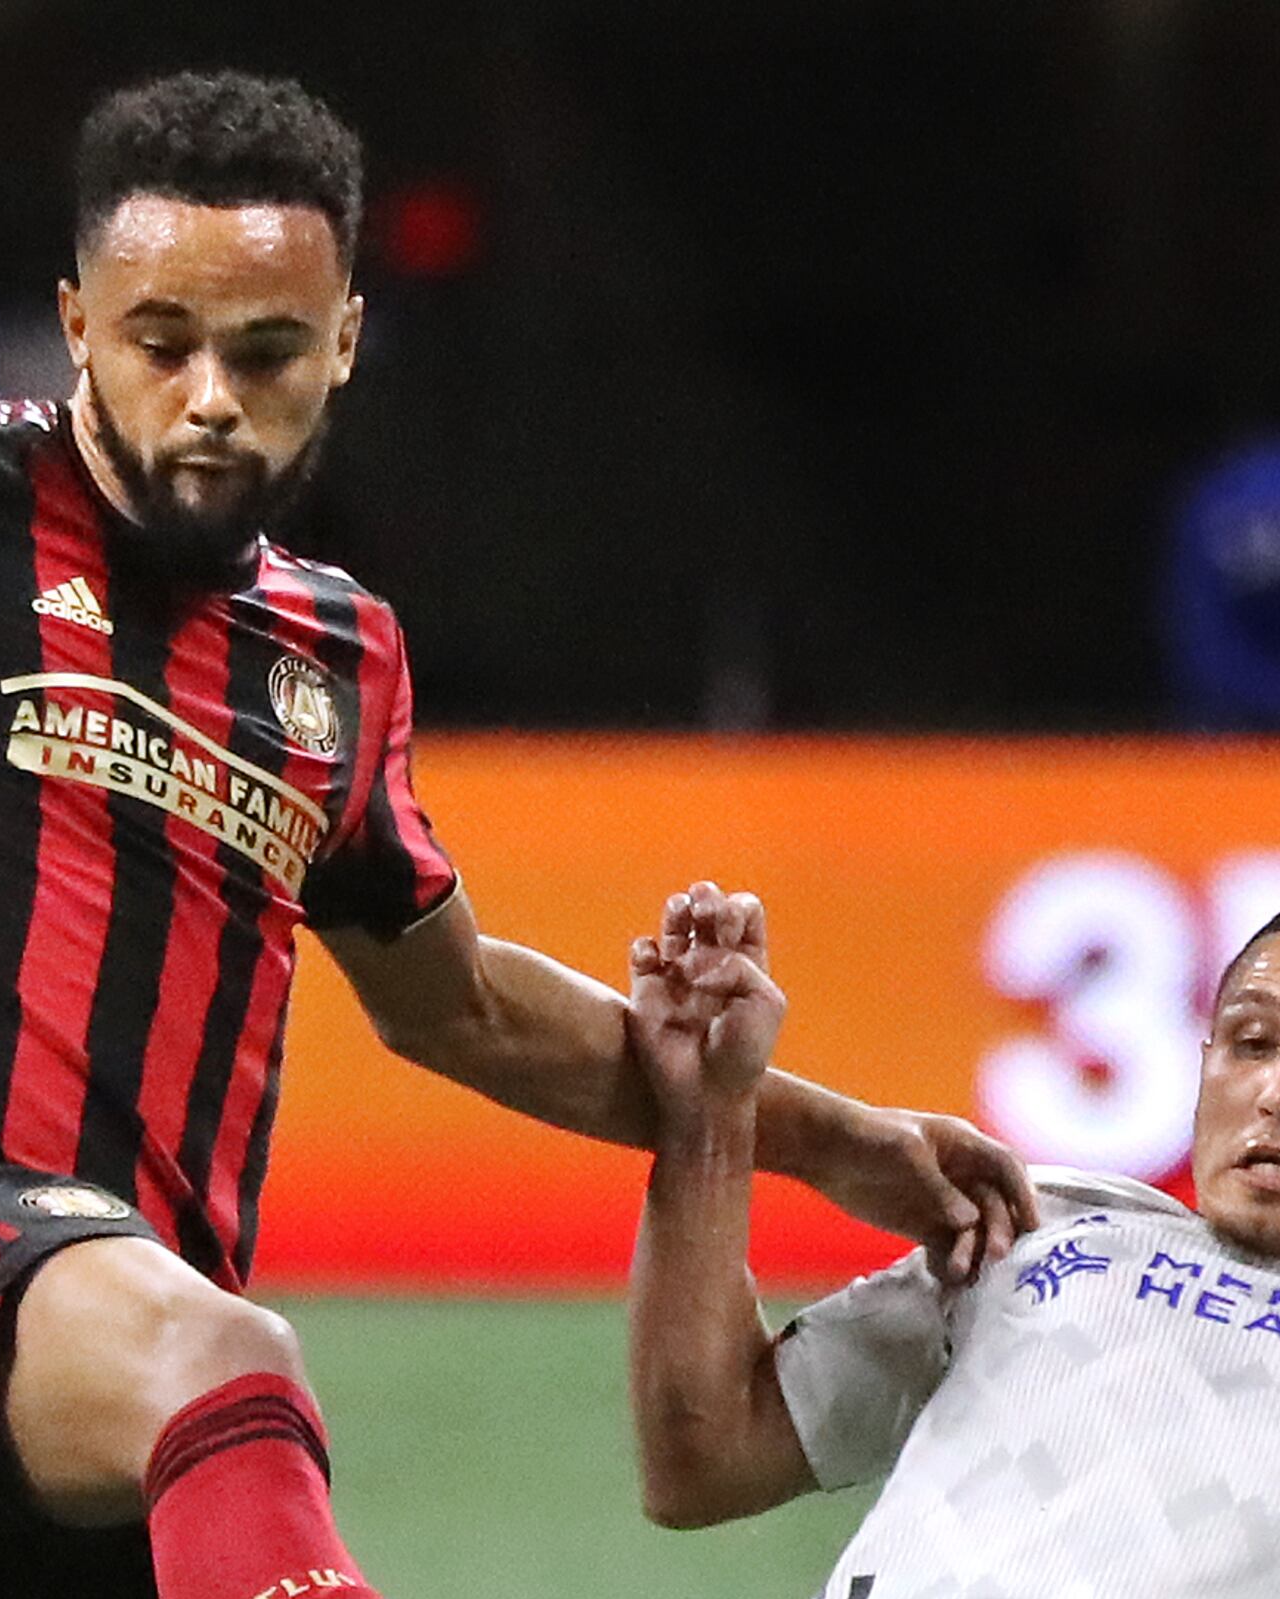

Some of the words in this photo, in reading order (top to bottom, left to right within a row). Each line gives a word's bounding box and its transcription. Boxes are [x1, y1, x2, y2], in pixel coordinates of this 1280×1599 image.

[31, 598, 113, 636] adidas
[10, 699, 217, 794] AMERICAN
[42, 746, 298, 882] INSURANCE
